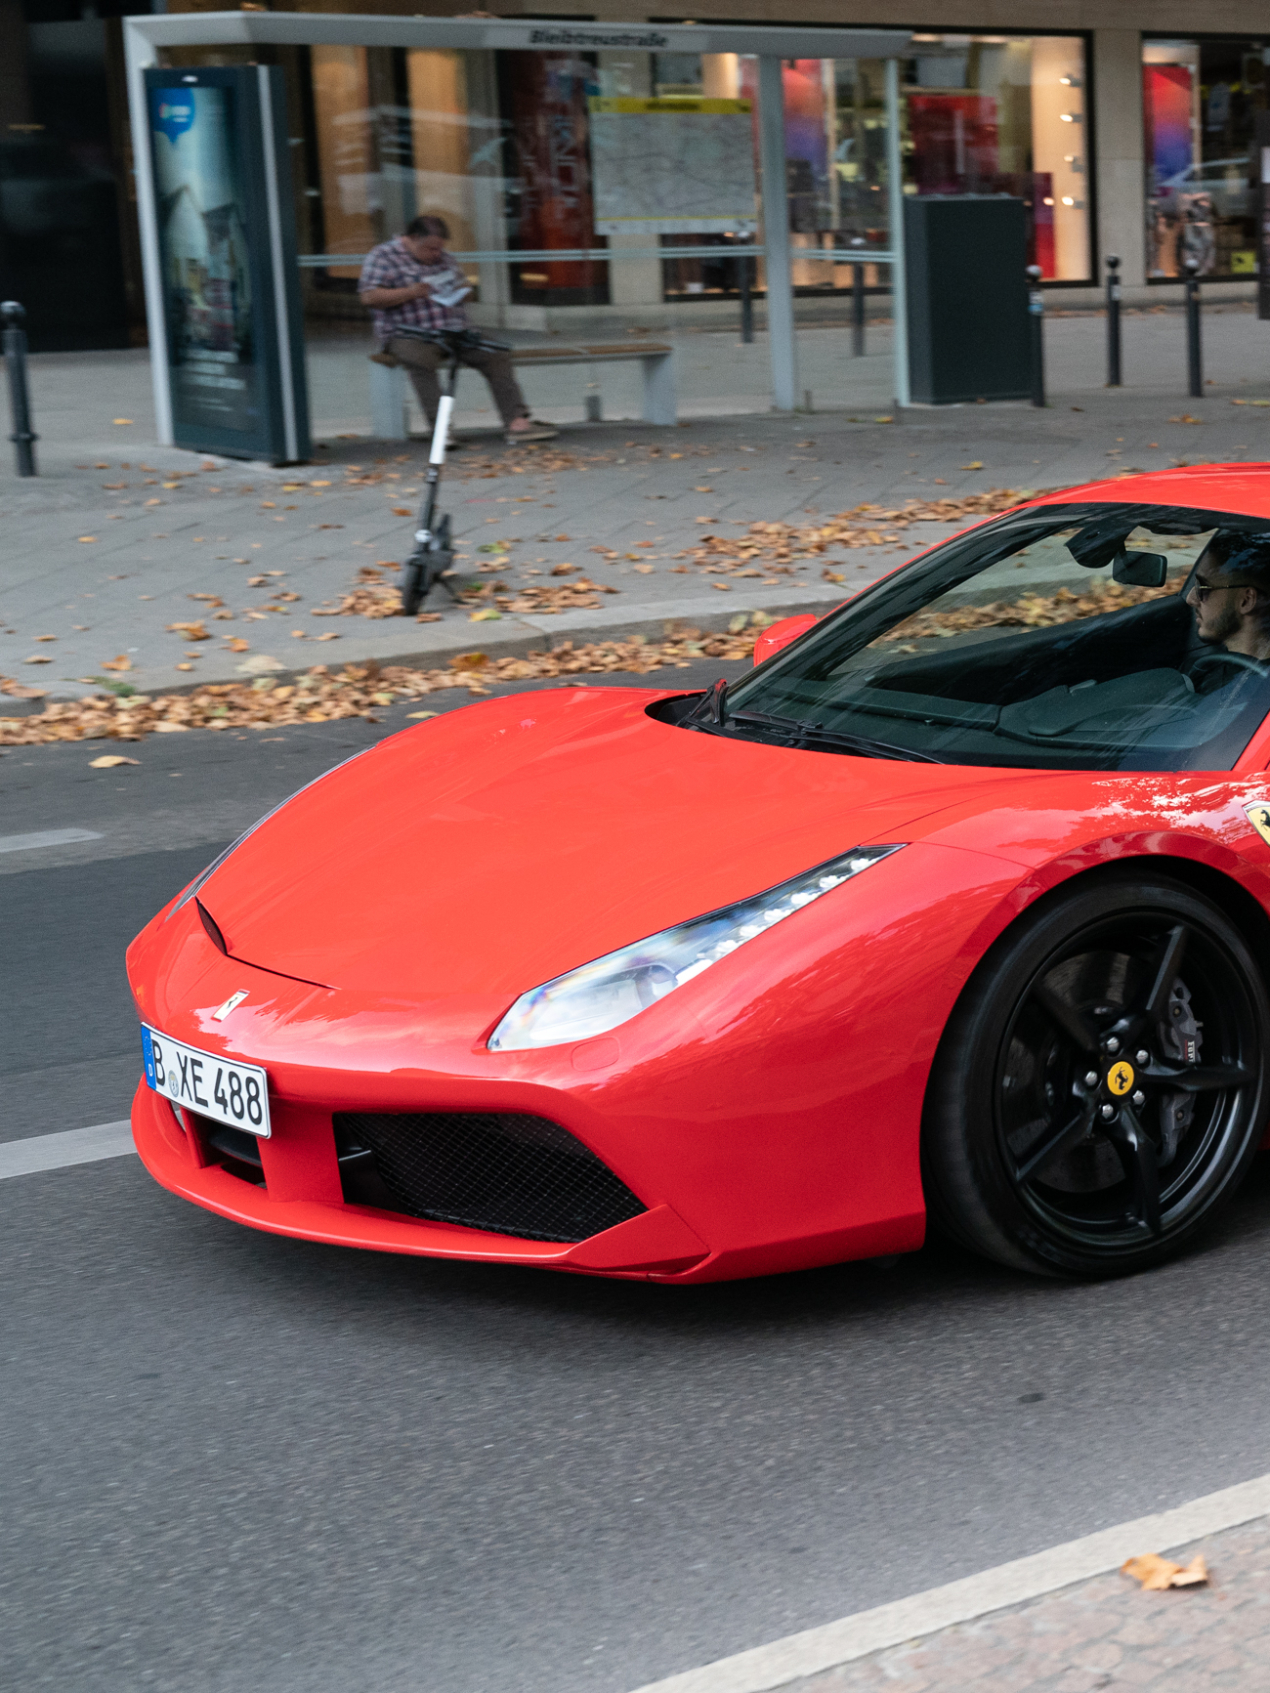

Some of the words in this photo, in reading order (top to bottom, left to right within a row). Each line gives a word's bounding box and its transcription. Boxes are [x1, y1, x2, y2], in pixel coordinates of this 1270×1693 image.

[151, 1039, 165, 1086] B
[176, 1051, 209, 1108] XE
[214, 1067, 262, 1125] 488
